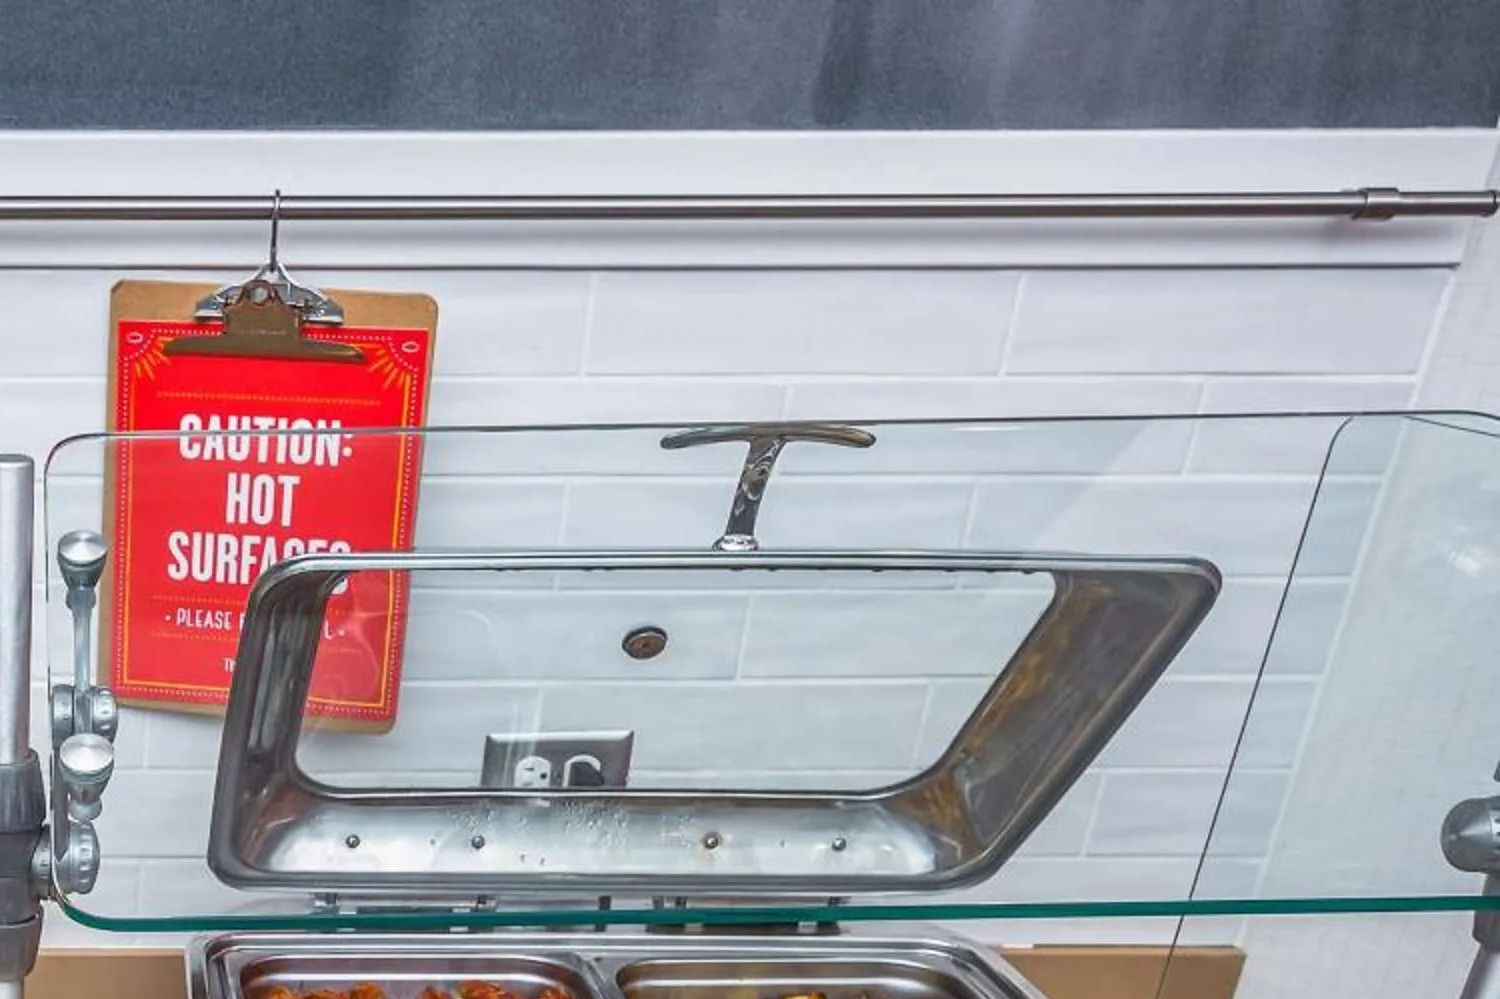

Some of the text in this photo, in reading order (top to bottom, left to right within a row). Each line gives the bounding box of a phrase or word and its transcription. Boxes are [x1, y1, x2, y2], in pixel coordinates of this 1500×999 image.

[179, 413, 353, 467] CAUTION:
[225, 471, 301, 527] HOT
[167, 530, 352, 594] SURFA
[176, 607, 232, 630] PLEASE
